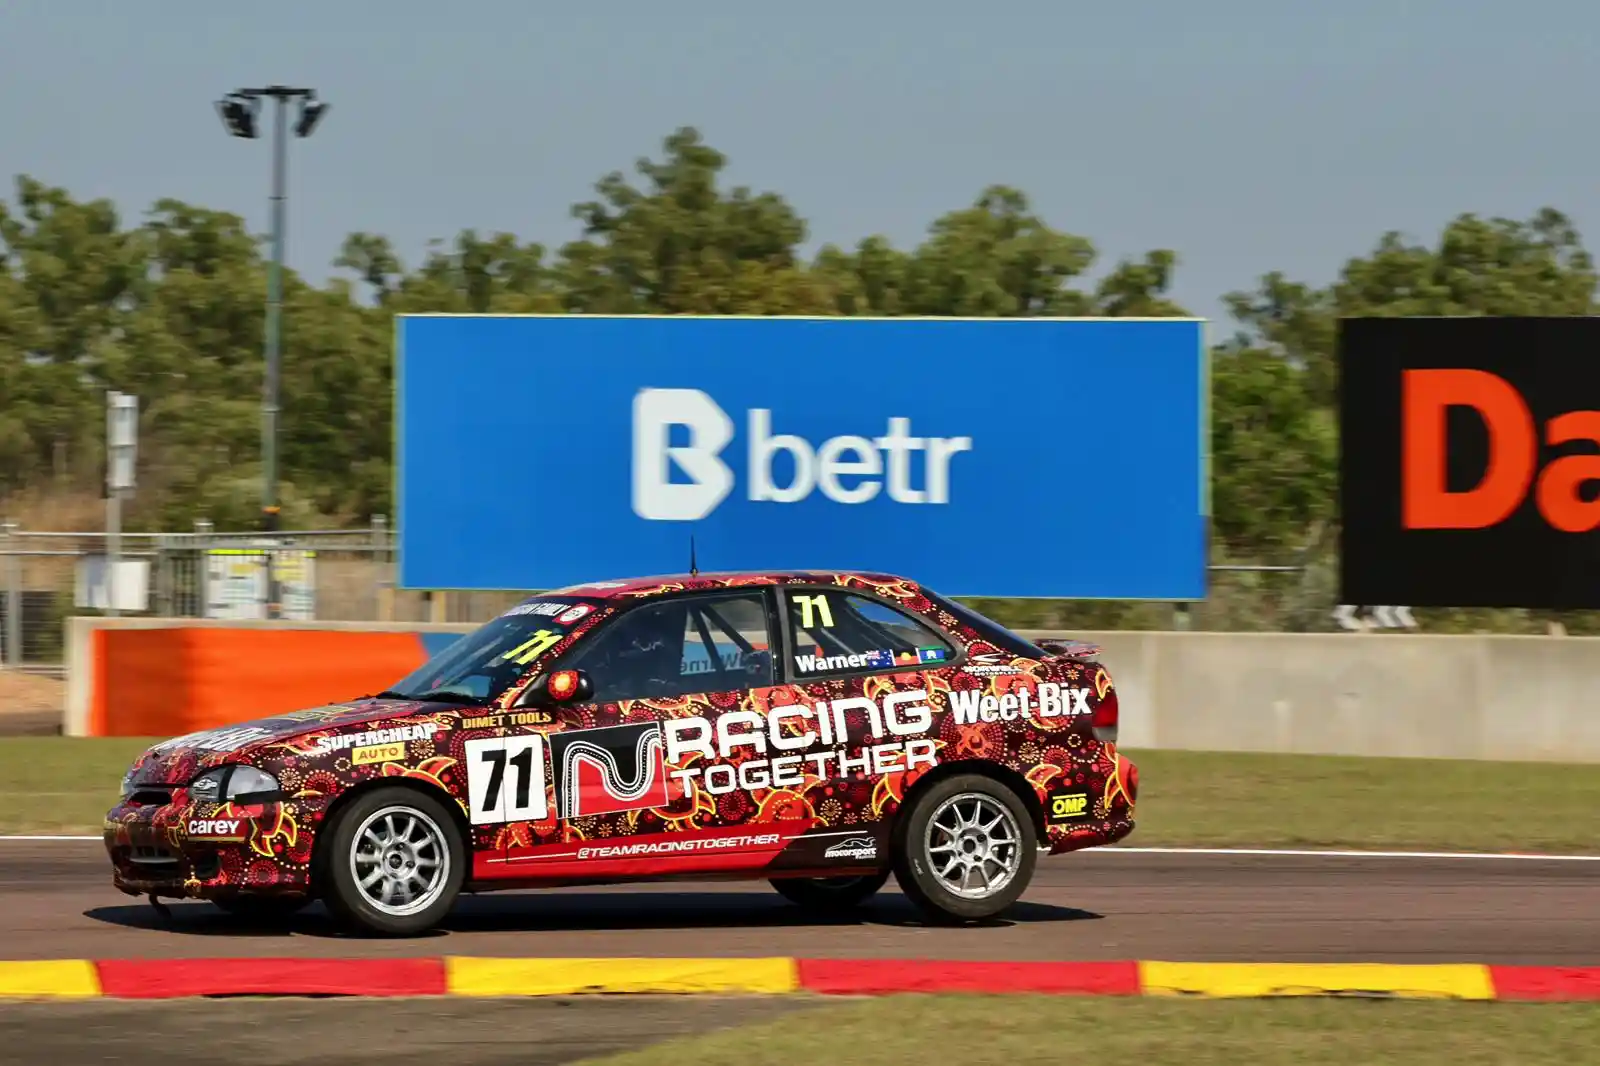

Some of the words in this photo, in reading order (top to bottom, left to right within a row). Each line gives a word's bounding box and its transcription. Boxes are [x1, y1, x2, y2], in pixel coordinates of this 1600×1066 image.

[747, 408, 972, 504] betr
[1401, 368, 1600, 532] Da
[792, 594, 834, 628] 71
[502, 629, 563, 665] 71
[795, 654, 867, 673] Warner
[462, 716, 504, 729] DIMET
[509, 712, 552, 725] TOOLS
[949, 682, 1092, 725] Weet-Bix
[317, 722, 438, 751] SUPERCHEAP
[664, 690, 932, 763] RACING
[358, 747, 398, 760] AUTO
[670, 739, 938, 798] TOGETHER
[481, 747, 532, 811] 71
[1052, 797, 1087, 814] OMP
[577, 834, 780, 859] @TEAMRACINGTOGETHER
